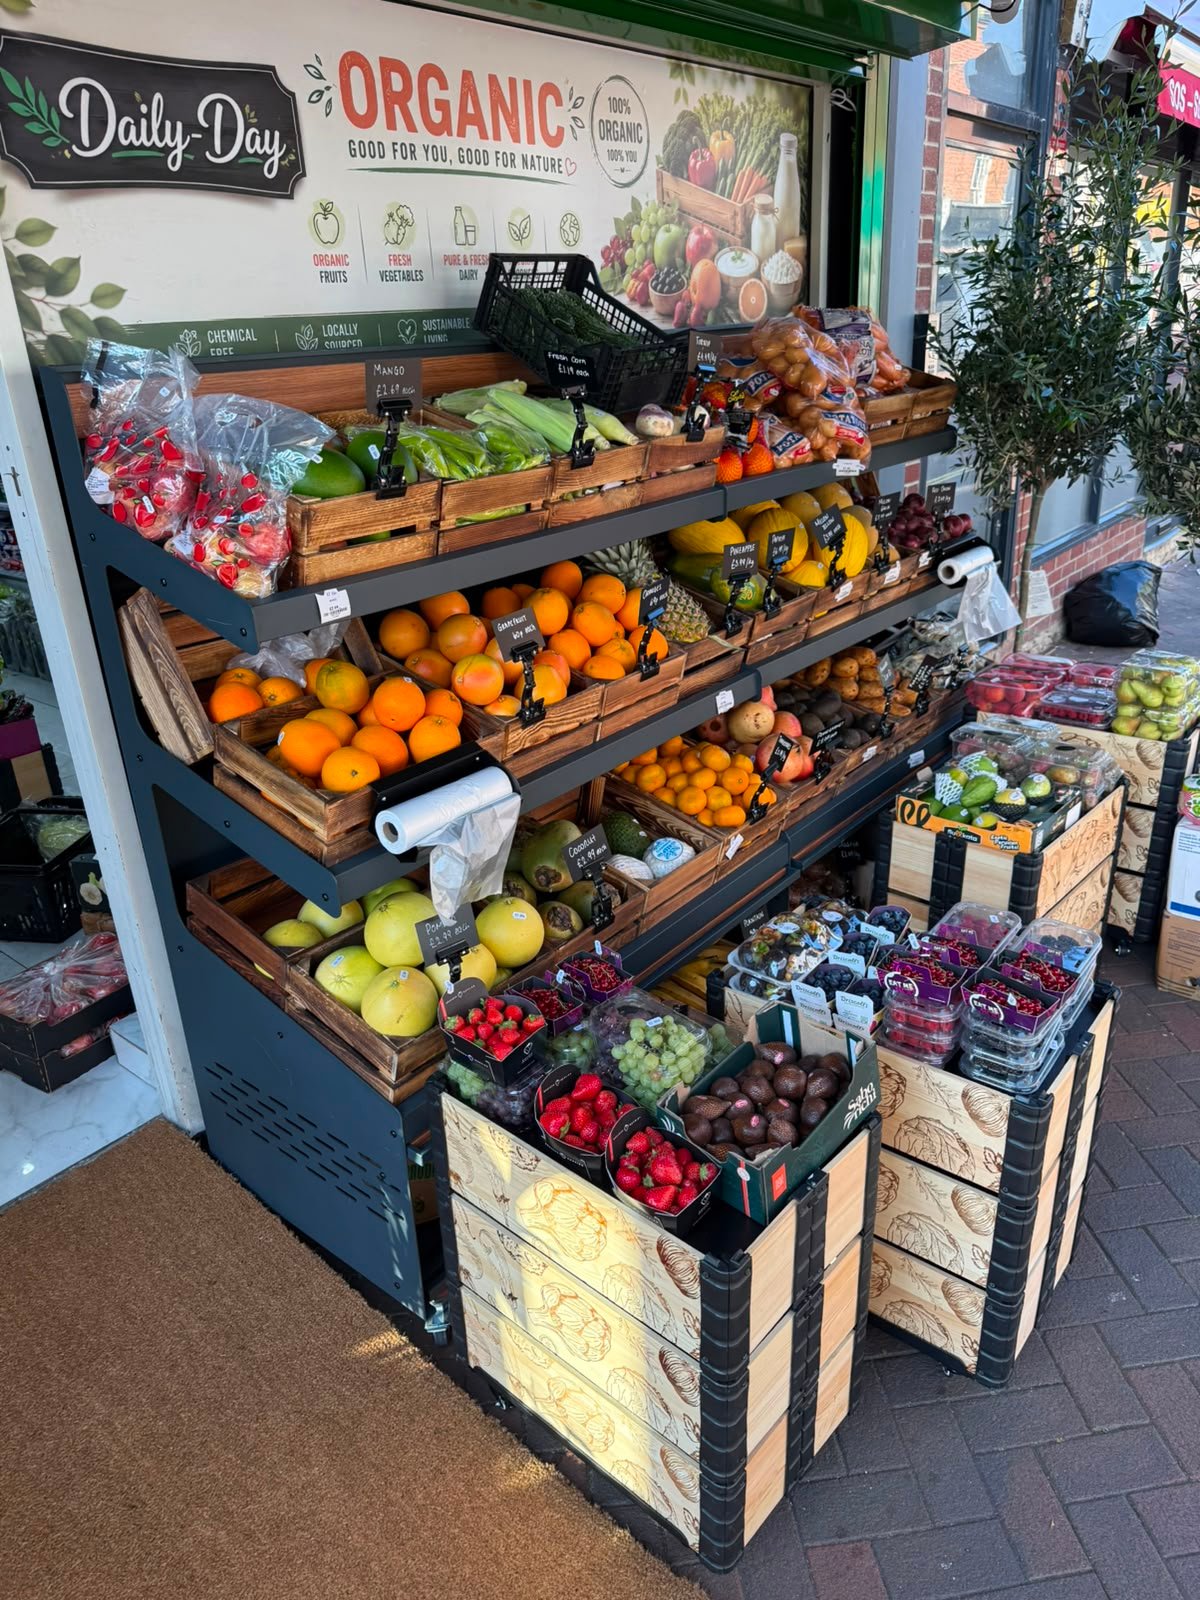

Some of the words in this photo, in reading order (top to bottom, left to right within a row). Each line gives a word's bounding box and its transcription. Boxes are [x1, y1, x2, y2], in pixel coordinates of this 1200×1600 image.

[338, 50, 565, 149] ORGANIC
[1169, 78, 1187, 113] SOS
[607, 96, 631, 115] 100%
[59, 76, 286, 179] Daily-Day
[598, 119, 643, 144] ORGANIC
[348, 139, 386, 160] GOOD
[391, 141, 417, 161] FOR
[422, 144, 453, 166] YOU,
[458, 146, 490, 167] GOOD
[495, 149, 517, 169] FOR
[521, 152, 564, 174] NATURE
[607, 148, 624, 162] 100%
[624, 150, 637, 163] YOU
[312, 253, 350, 267] ORGANIC
[388, 254, 412, 267] FRESH
[443, 254, 463, 266] PURE
[463, 254, 469, 266] &
[319, 270, 348, 284] FRUITS
[379, 269, 424, 283] VEGETABLES
[459, 269, 478, 281] DAIRY
[322, 323, 358, 337] LOCALLY
[422, 317, 470, 331] SUSTAINABLE
[207, 328, 258, 343] CHEMICAL
[429, 929, 453, 949] £2.99
[888, 979, 901, 988] EAT
[902, 982, 914, 991] ME
[974, 1000, 987, 1010] EAT
[988, 1006, 1000, 1015] ME
